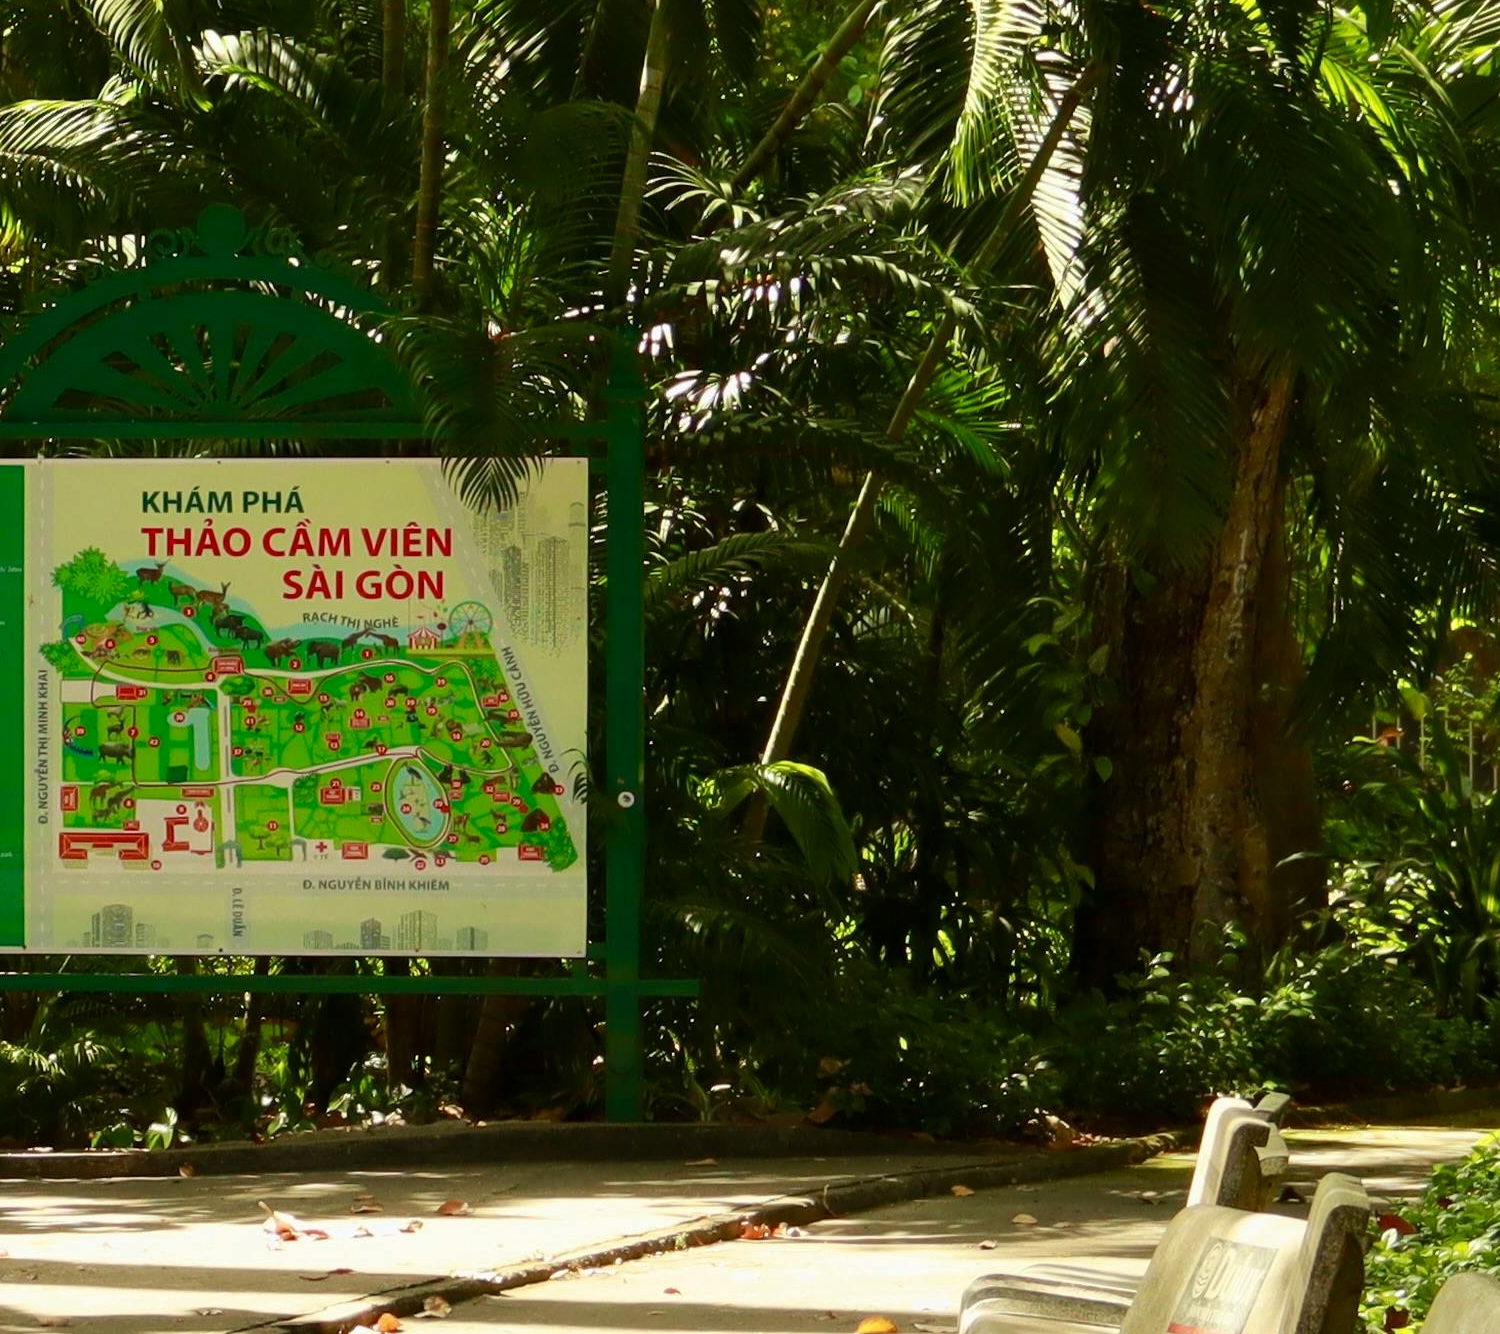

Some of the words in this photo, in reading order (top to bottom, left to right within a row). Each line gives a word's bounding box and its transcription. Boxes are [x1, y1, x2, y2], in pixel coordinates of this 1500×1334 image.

[141, 486, 233, 513] KHÁM
[242, 485, 305, 513] PHÁ
[141, 517, 251, 557] THẢO
[261, 517, 351, 557] CẦM
[361, 521, 452, 557] VIÊN
[282, 564, 343, 600] SÀI
[355, 564, 444, 600] GÒN
[37, 669, 48, 699] KHAI
[38, 701, 48, 735] MINH
